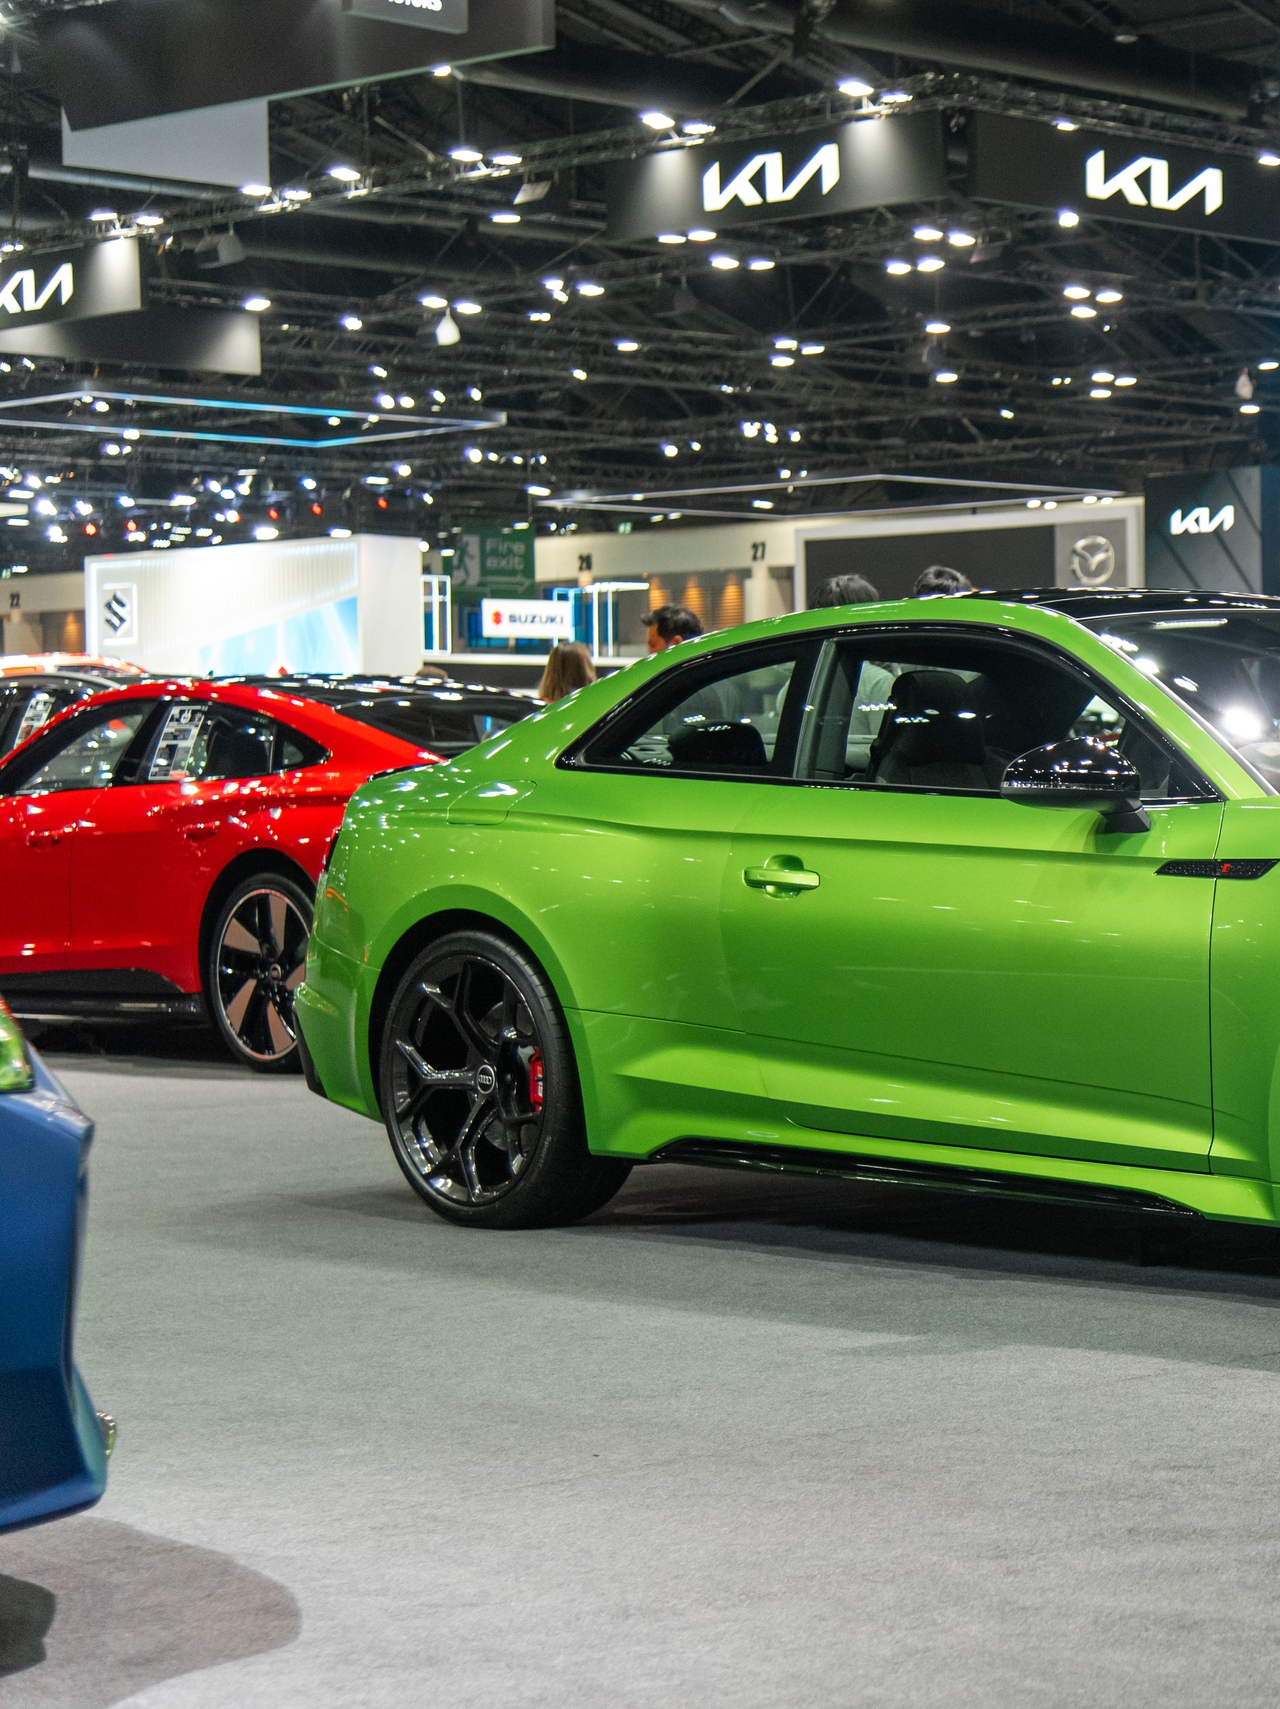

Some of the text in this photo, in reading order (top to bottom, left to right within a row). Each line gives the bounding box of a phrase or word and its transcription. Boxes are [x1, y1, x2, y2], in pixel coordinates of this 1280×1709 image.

[703, 143, 840, 212] KIA
[1085, 150, 1223, 215] KIA
[1170, 504, 1235, 535] KIA
[485, 538, 526, 554] Fire
[485, 557, 524, 570] exit
[508, 614, 564, 624] SUZUKI
